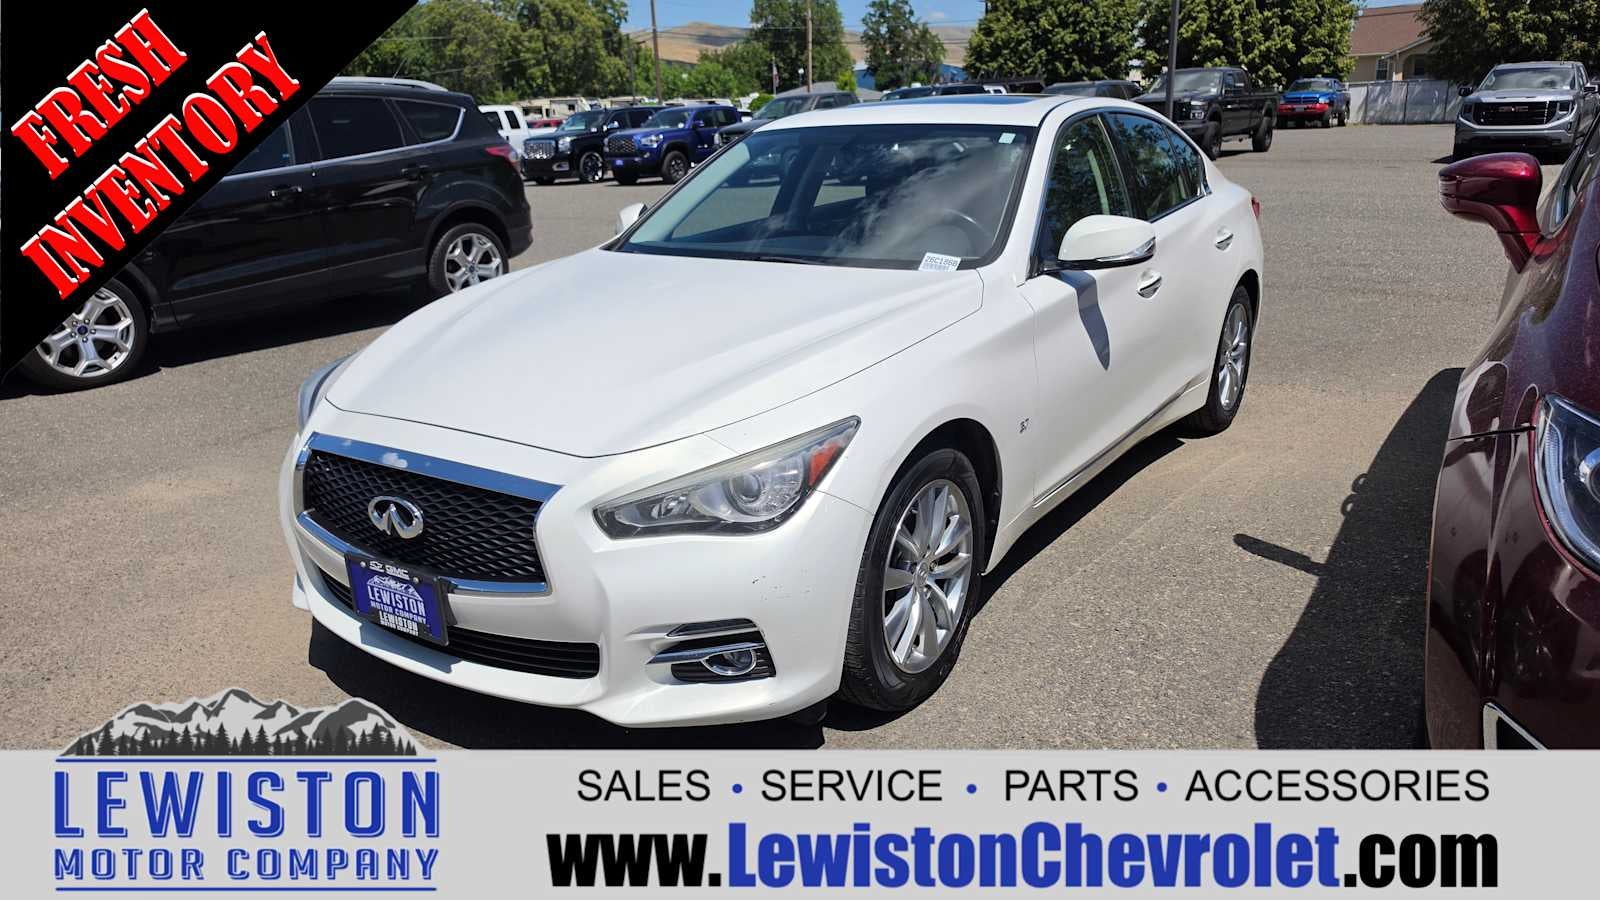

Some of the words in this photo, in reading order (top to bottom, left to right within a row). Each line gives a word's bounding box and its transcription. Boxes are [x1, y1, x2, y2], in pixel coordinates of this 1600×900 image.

[367, 585, 426, 617] LEWISTON
[370, 601, 393, 614] MOTOR
[394, 608, 427, 625] COMPANY
[379, 610, 419, 632] LEWISTON
